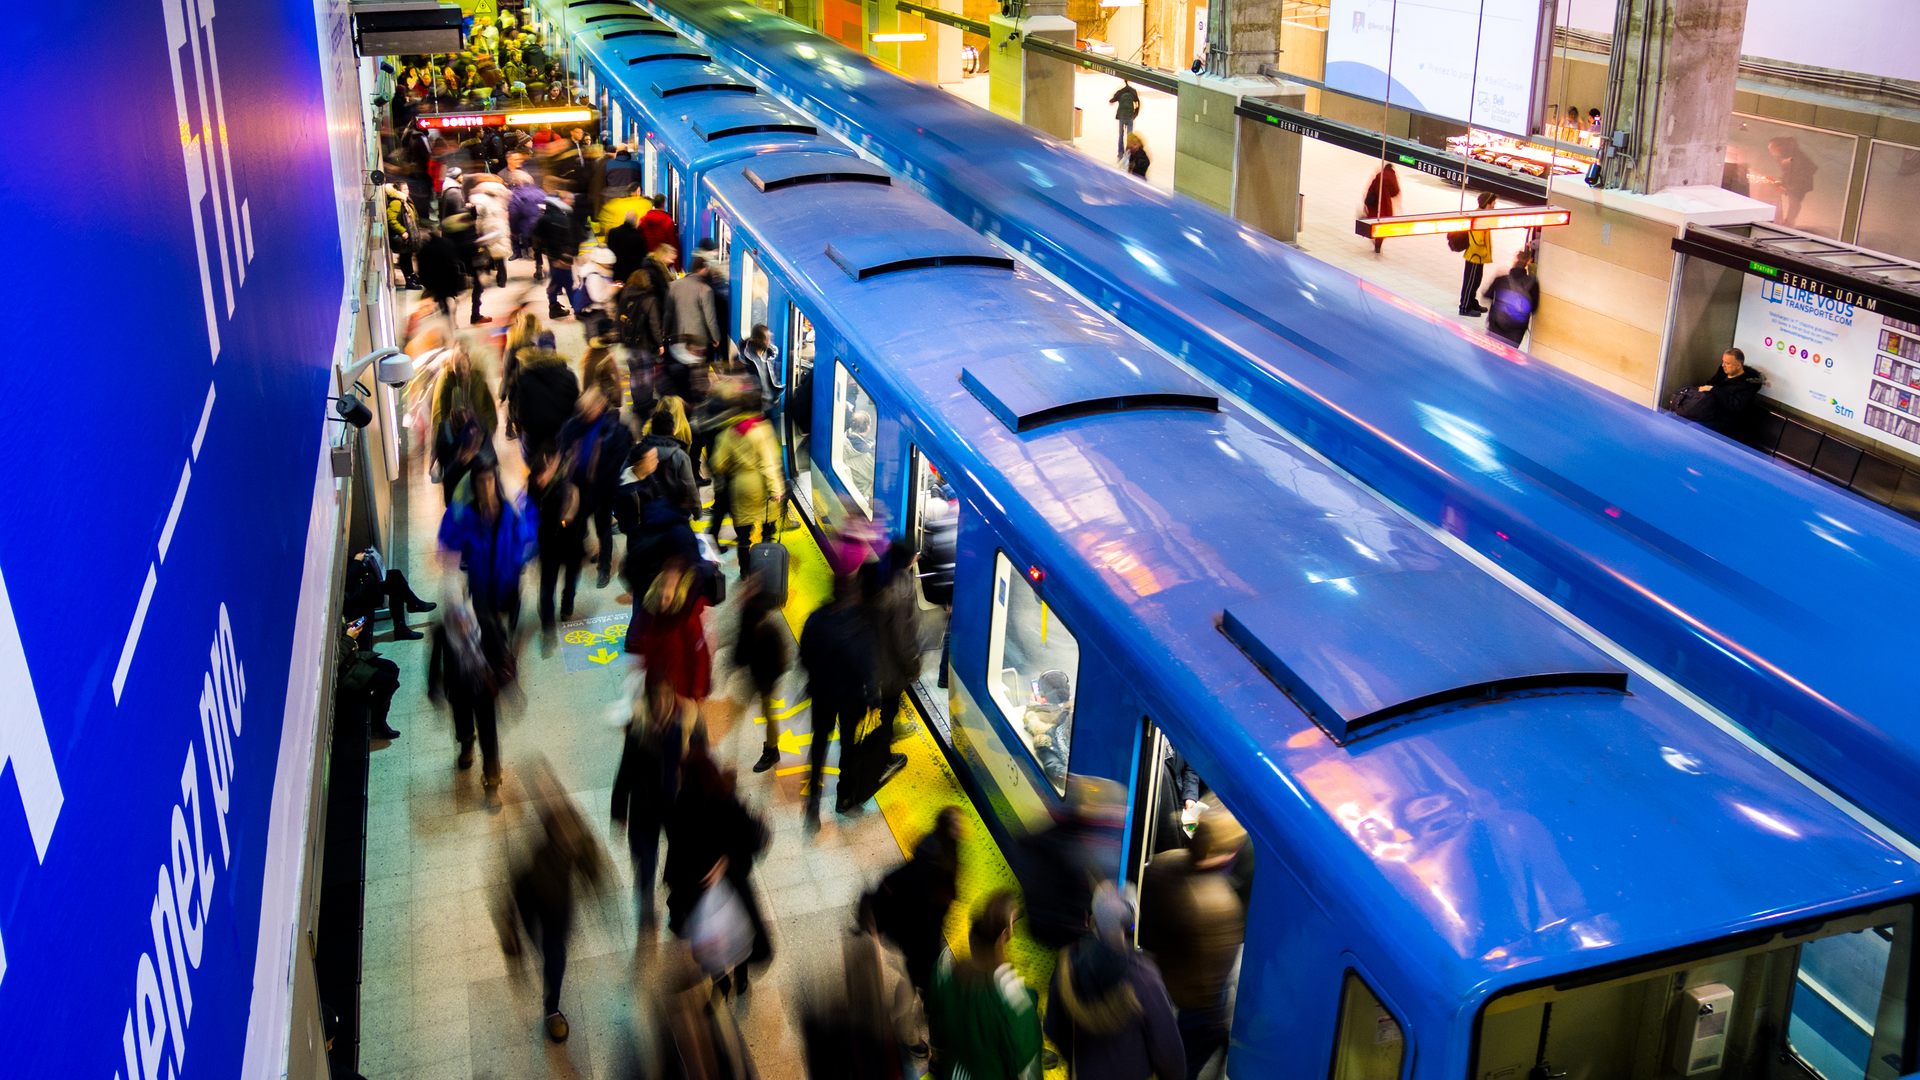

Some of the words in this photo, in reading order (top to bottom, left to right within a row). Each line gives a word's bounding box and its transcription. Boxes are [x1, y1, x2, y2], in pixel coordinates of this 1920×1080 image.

[1428, 62, 1450, 76] Prenez
[1451, 67, 1458, 77] la
[1458, 71, 1482, 83] paroe.
[1485, 75, 1524, 92] #BellCause
[1492, 94, 1505, 106] Bell
[1491, 105, 1508, 116] Cause
[1507, 110, 1521, 119] pour
[1496, 115, 1512, 124] cause
[442, 116, 484, 128] SORTIE
[1280, 120, 1320, 139] BERRI-UQAM
[1497, 213, 1545, 228] SORTIE
[1782, 272, 1877, 311] BERRI-UQAM
[1786, 285, 1815, 306] LIRE
[1818, 294, 1855, 318] VOUS
[1785, 299, 1853, 327] TRANSPORTE.COM
[1834, 404, 1854, 419] stm
[199, 601, 247, 872] pro.
